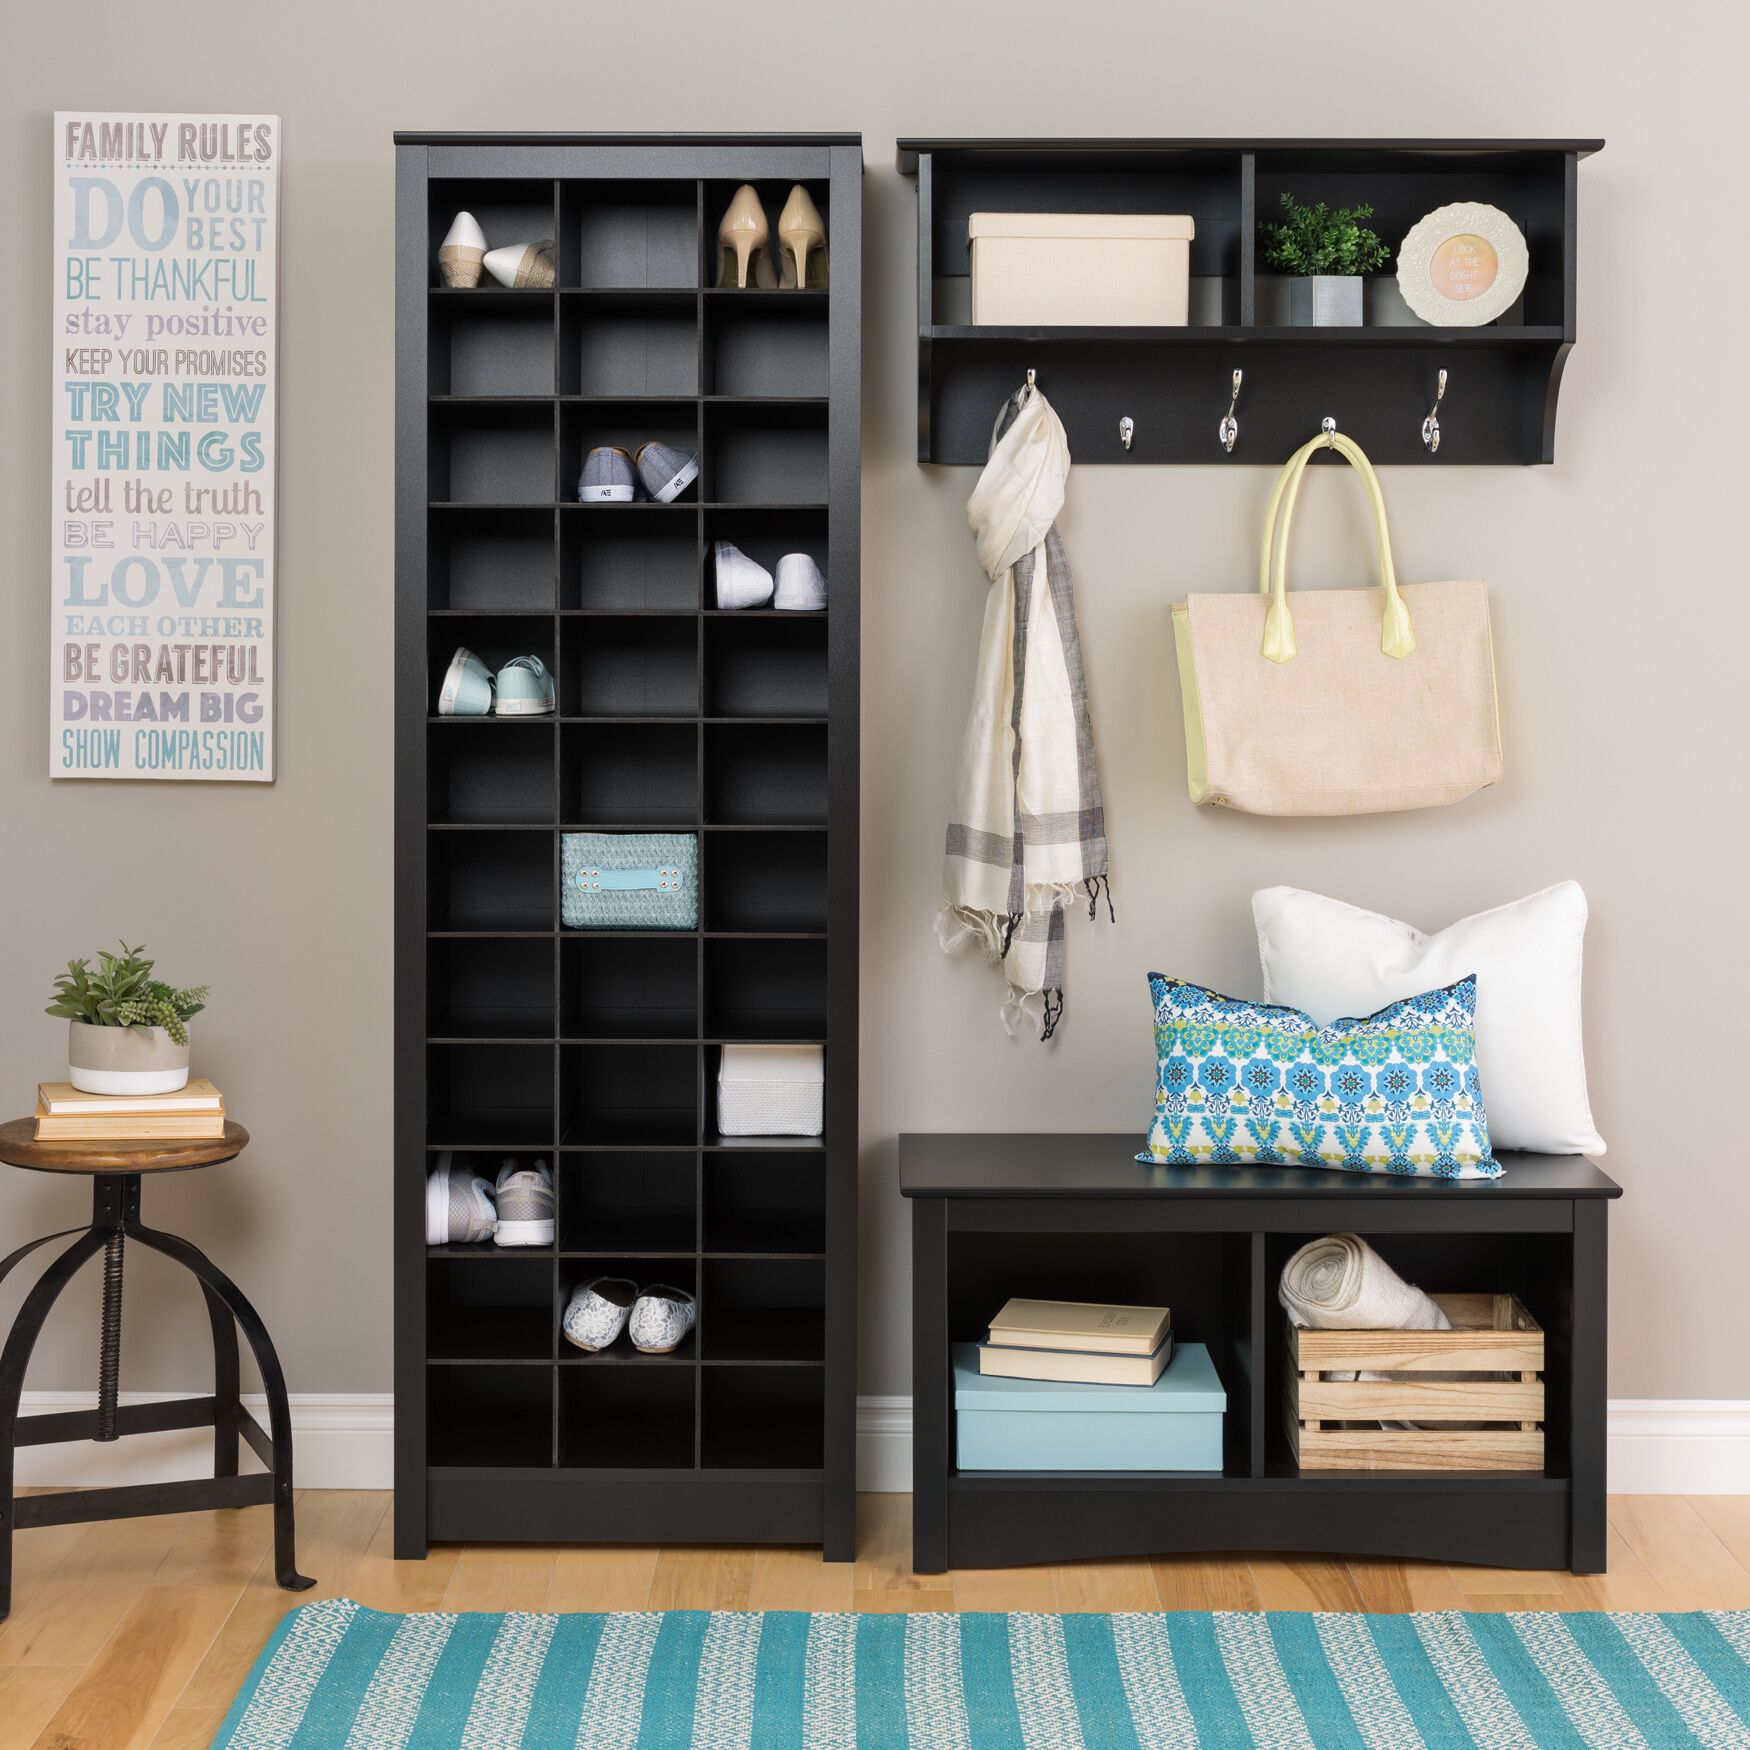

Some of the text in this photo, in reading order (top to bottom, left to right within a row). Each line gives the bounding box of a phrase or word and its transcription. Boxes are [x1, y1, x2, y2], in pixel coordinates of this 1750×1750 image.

[65, 121, 273, 163] FAMILY RULES
[68, 176, 180, 252] DO
[182, 178, 266, 214] YOUR
[186, 216, 268, 252] BEST
[1453, 244, 1478, 255] LOOK
[66, 256, 268, 302] BE THANKFUL
[1449, 257, 1481, 268] AT THE
[1449, 270, 1479, 281] BRIGHT
[65, 305, 268, 342] stay positive
[65, 347, 267, 377] KEEP YOUR PROMISES
[64, 381, 267, 424] TRY NEW
[64, 429, 265, 473] THINGS
[65, 477, 265, 516] tell the truth
[63, 520, 265, 550] BE HAPPY
[63, 555, 265, 609] LOVE
[64, 615, 265, 638] EACH OTHER
[63, 642, 265, 686] BE GRATEFUL
[63, 690, 264, 724] DREAM BIG
[62, 728, 265, 771] SHOW COMPASSION
